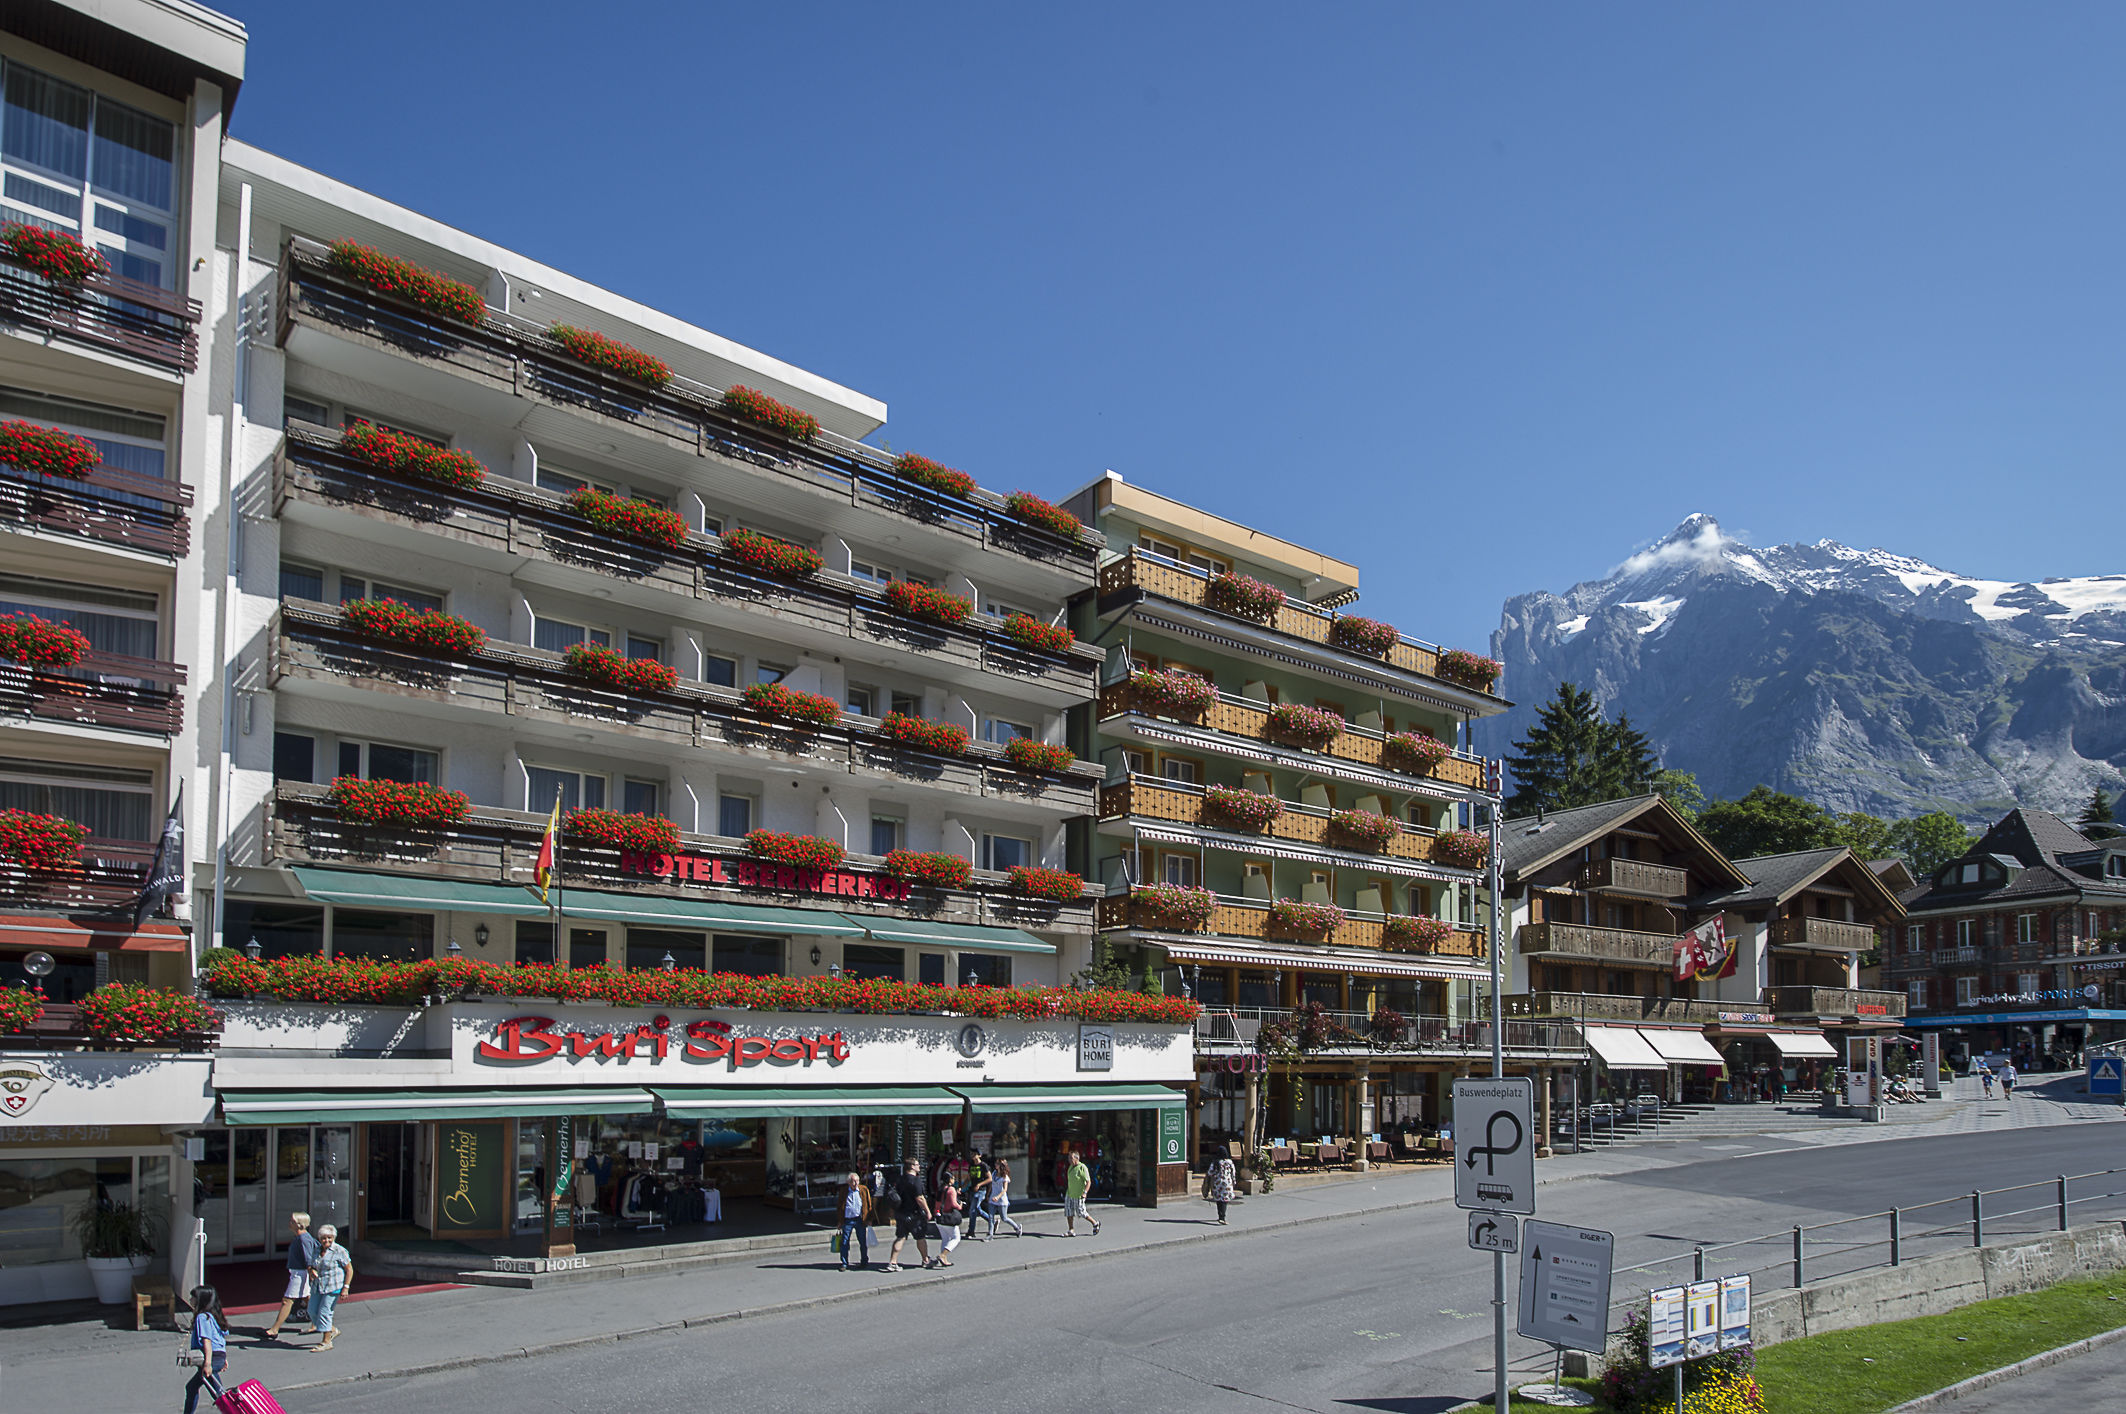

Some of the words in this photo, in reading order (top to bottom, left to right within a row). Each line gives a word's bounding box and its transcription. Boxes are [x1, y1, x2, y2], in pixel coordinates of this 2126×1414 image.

[621, 849, 729, 884] HOTEL
[738, 860, 913, 902] BERNERHOF
[2086, 960, 2125, 970] TISSOT
[480, 1015, 670, 1060] Buri
[686, 1020, 850, 1066] Sport
[1083, 1039, 1111, 1049] BURI
[1083, 1051, 1111, 1061] HOME
[1207, 1053, 1267, 1074] HOTE
[1459, 1087, 1523, 1099] Buswendeplatz
[469, 1134, 478, 1168] HOTEL
[556, 1114, 571, 1191] Bernerho
[443, 1128, 480, 1225] Bernerhof
[1486, 1234, 1499, 1247] 25
[1502, 1239, 1513, 1249] m
[495, 1261, 533, 1272] HOTEL
[546, 1257, 591, 1271] HOTEL
